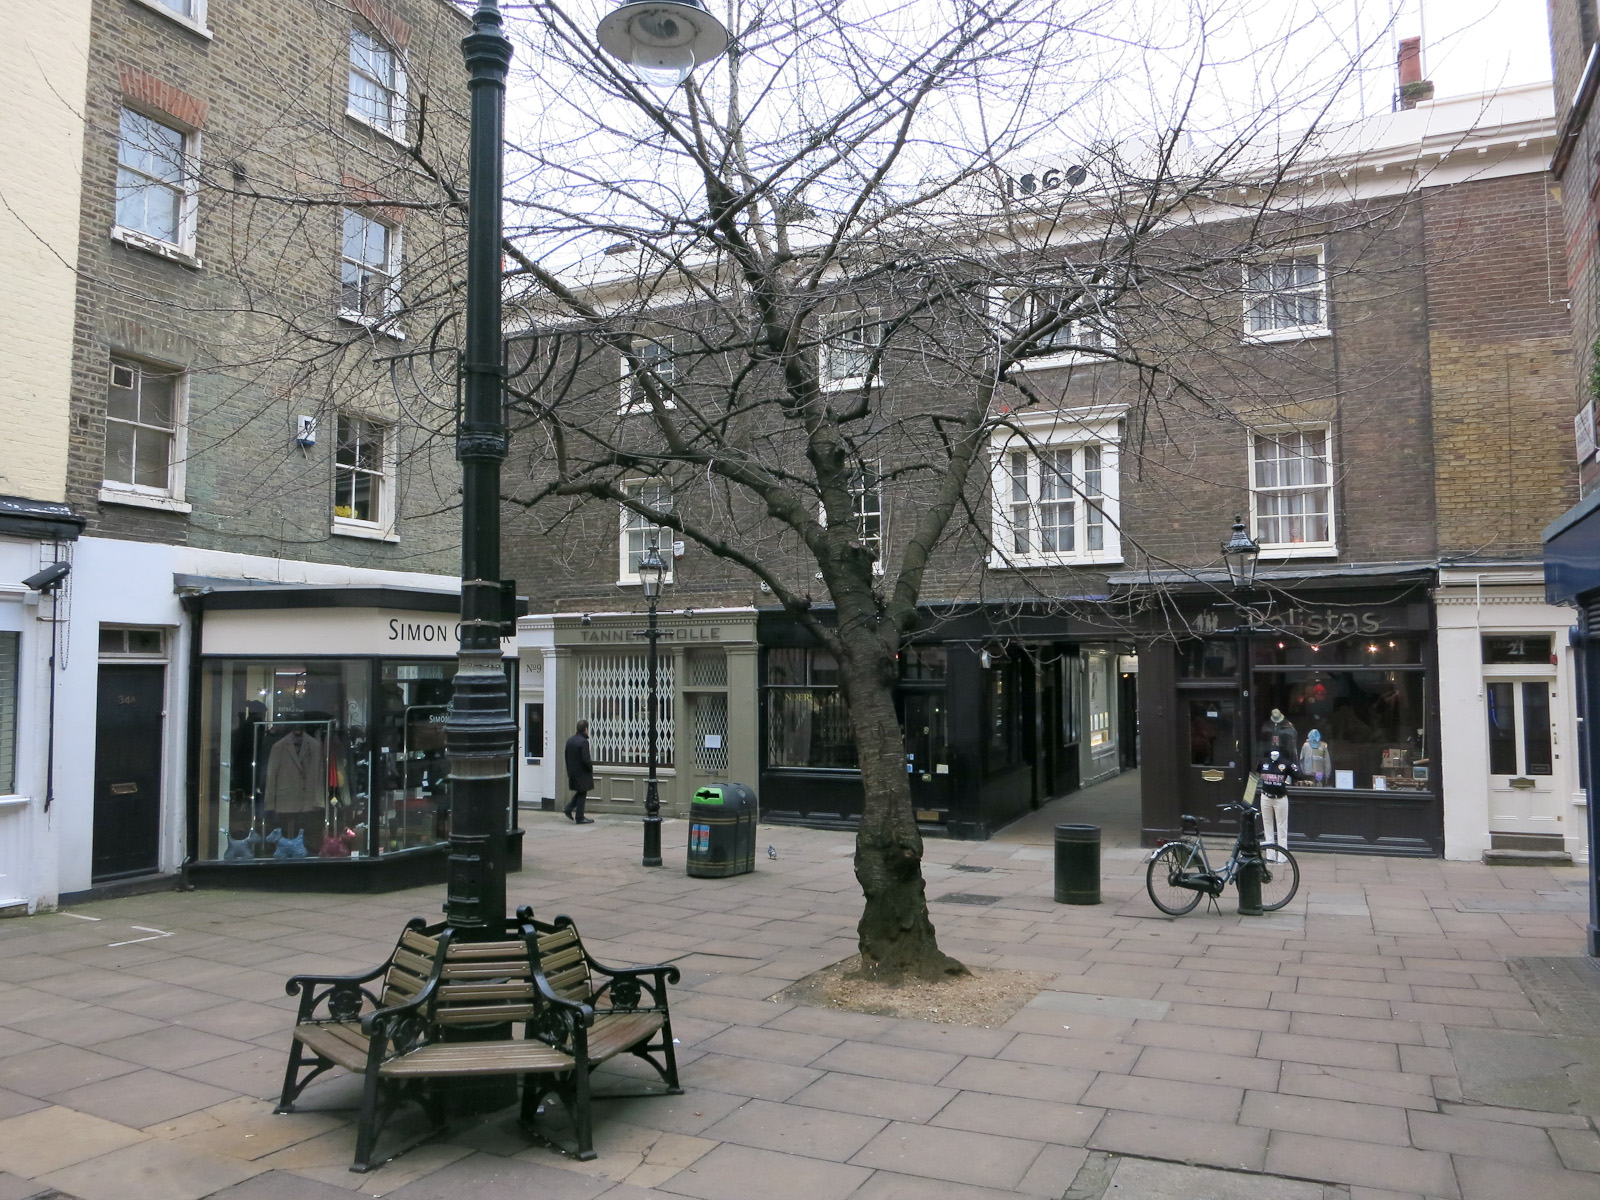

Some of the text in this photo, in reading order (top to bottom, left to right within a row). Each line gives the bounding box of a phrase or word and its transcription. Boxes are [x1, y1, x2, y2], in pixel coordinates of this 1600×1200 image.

[1007, 164, 1087, 198] 1860
[388, 618, 448, 642] SIMON
[1507, 643, 1526, 655] 21
